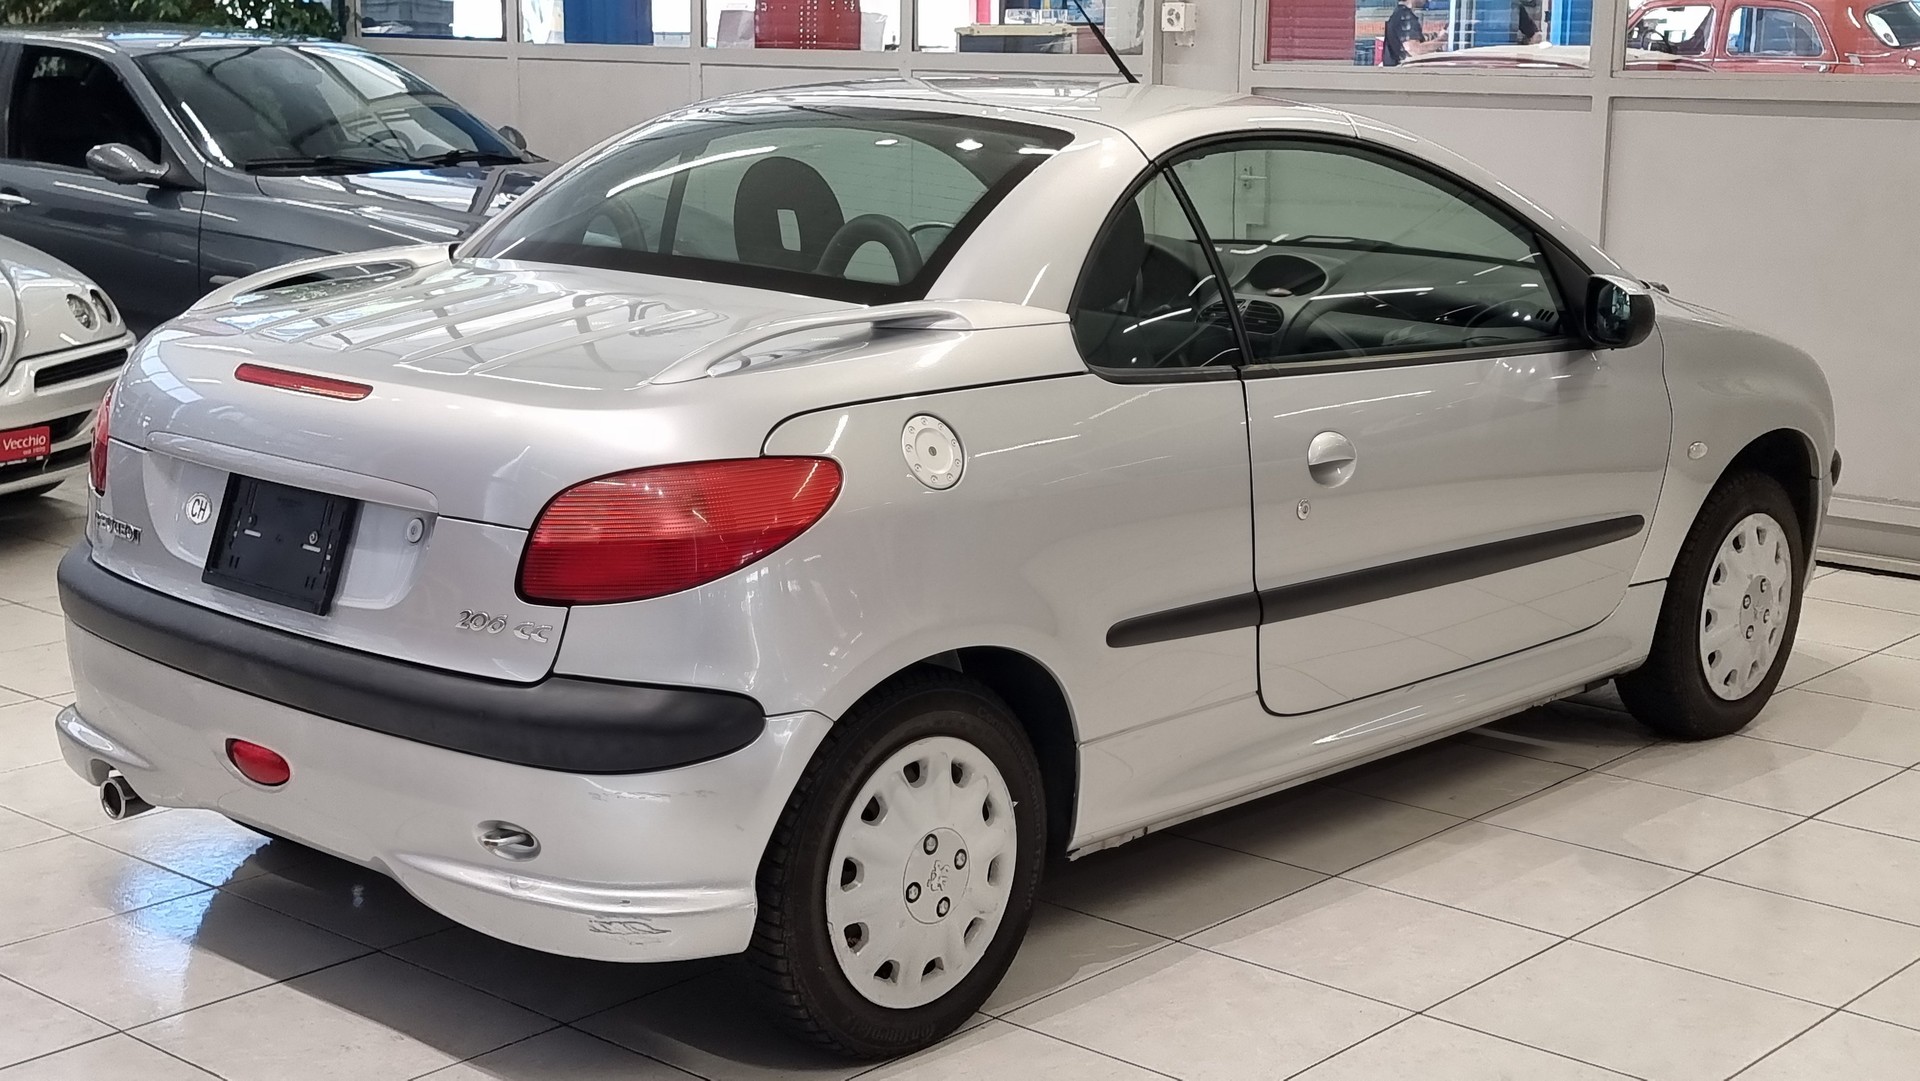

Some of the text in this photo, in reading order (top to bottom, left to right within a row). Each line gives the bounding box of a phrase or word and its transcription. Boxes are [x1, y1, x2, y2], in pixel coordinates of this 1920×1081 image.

[2, 434, 47, 451] Vecchio
[191, 498, 208, 521] CH
[455, 608, 554, 644] 206 CC
